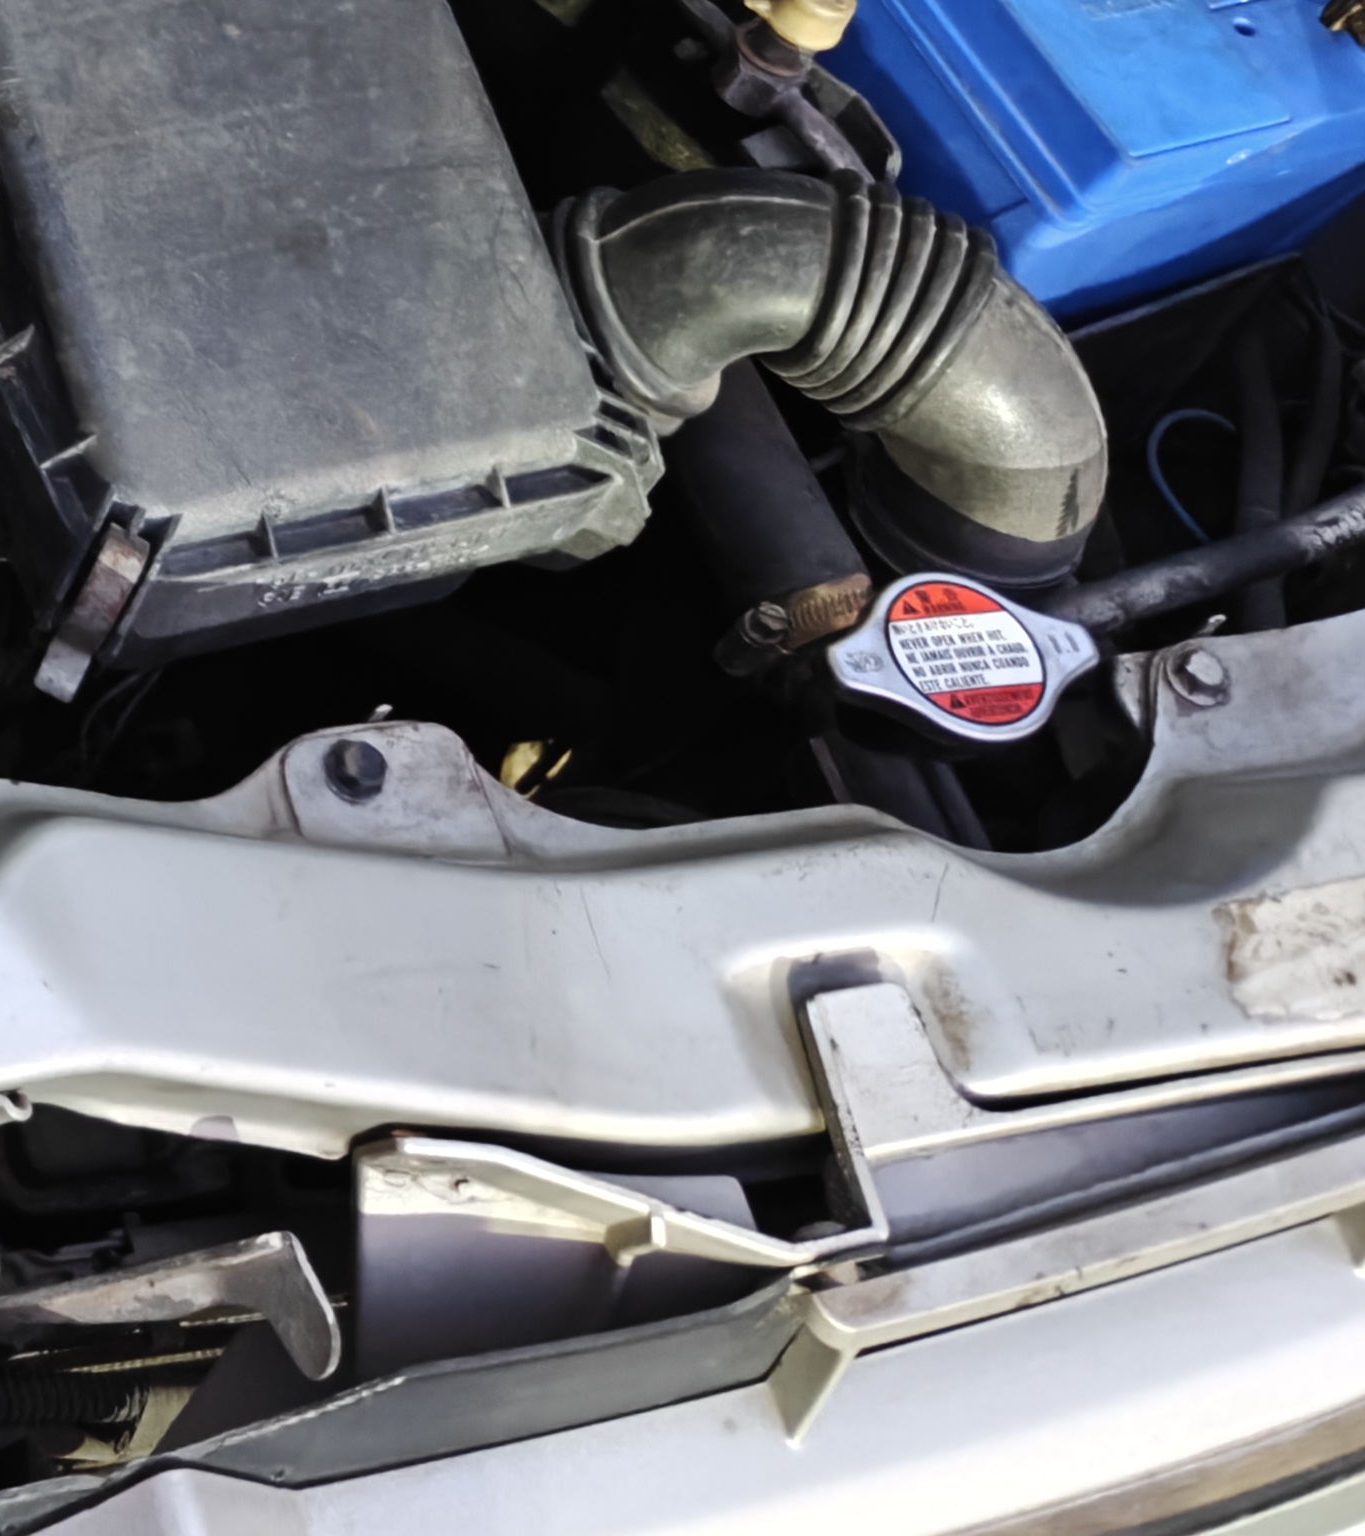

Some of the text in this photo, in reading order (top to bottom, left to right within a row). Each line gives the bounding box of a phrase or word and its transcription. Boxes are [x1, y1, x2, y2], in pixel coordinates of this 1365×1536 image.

[898, 636, 929, 651] NEVER
[931, 634, 957, 648] OPEN
[959, 631, 985, 645] WHEN
[905, 652, 919, 664] NE
[920, 648, 953, 663] JAMAIS
[912, 656, 1030, 678] NO ABRIR NUNCA CUANDO
[919, 679, 942, 693] ESTE
